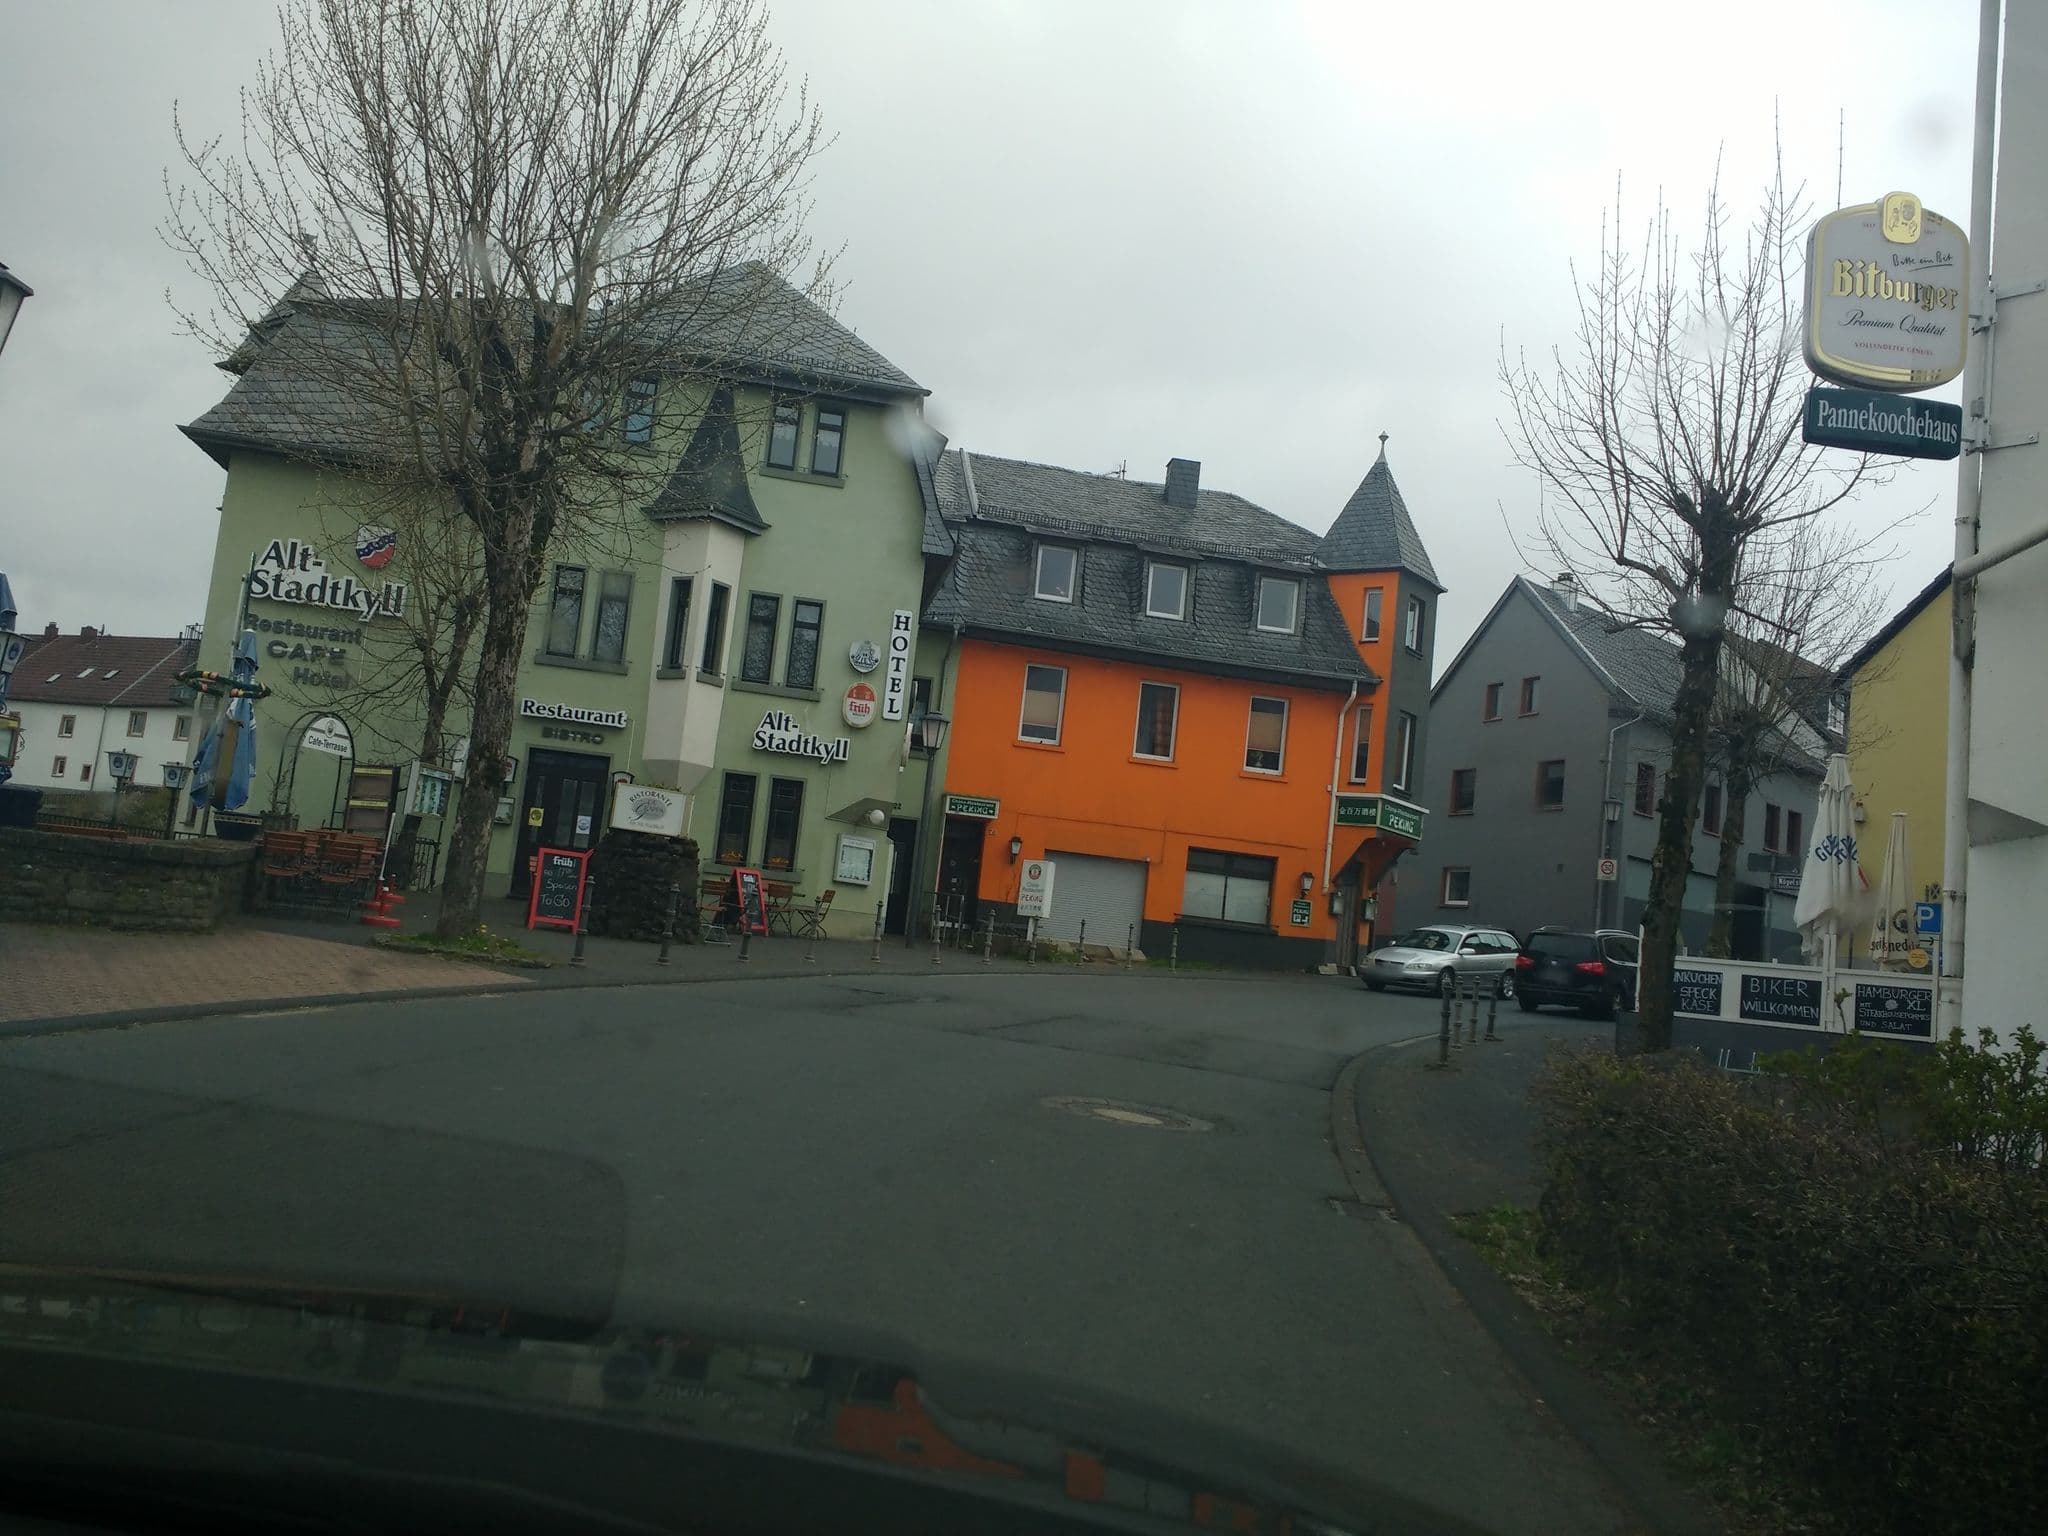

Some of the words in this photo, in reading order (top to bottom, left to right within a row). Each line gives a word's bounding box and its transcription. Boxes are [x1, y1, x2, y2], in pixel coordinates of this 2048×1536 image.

[1829, 259, 1959, 312] Bitburger
[1839, 309, 1895, 329] Premium
[1817, 400, 1959, 444] Pannekoochehaus
[260, 540, 323, 572] Alt-
[250, 569, 406, 620] Stadtkyll
[887, 614, 911, 714] HOTEL
[523, 699, 626, 726] Restaurant
[848, 701, 871, 715] früh
[760, 712, 799, 732] Alt-
[543, 726, 604, 744] BISTRO
[754, 731, 849, 764] Stadtkyll
[956, 804, 988, 815] PEKING
[1389, 814, 1414, 833] PEKING
[553, 856, 573, 867] früh
[1917, 907, 1935, 928] P
[1680, 987, 1716, 999] SPECK
[1750, 978, 1808, 997] BIKER
[1857, 986, 1932, 1000] HAMBURGER
[1743, 999, 1819, 1019] WILLKOMMEN
[1907, 1000, 1926, 1011] XL
[1881, 1021, 1912, 1031] SALAT
